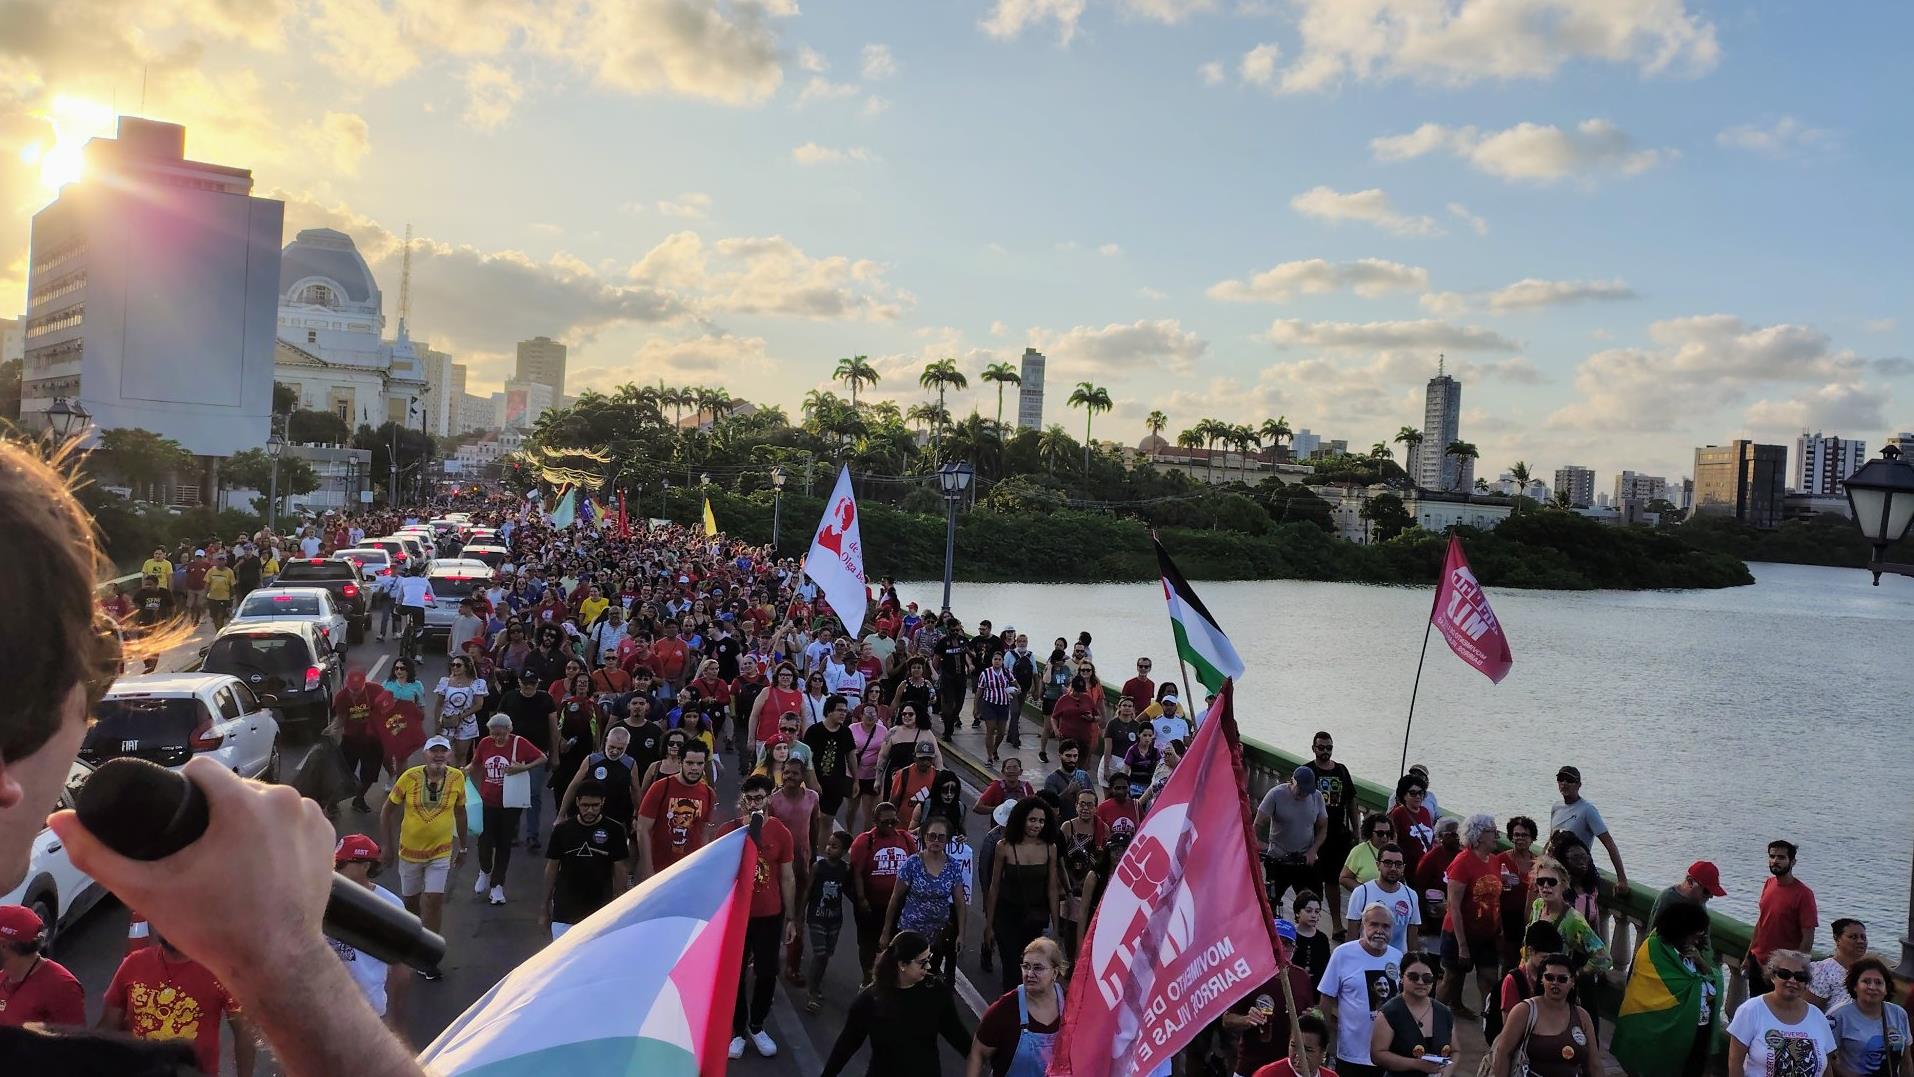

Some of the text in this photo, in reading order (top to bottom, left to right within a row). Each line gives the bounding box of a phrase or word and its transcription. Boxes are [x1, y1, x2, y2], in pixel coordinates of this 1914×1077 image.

[849, 542, 859, 553] de
[841, 552, 856, 573] Olga
[121, 740, 139, 752] FIAT
